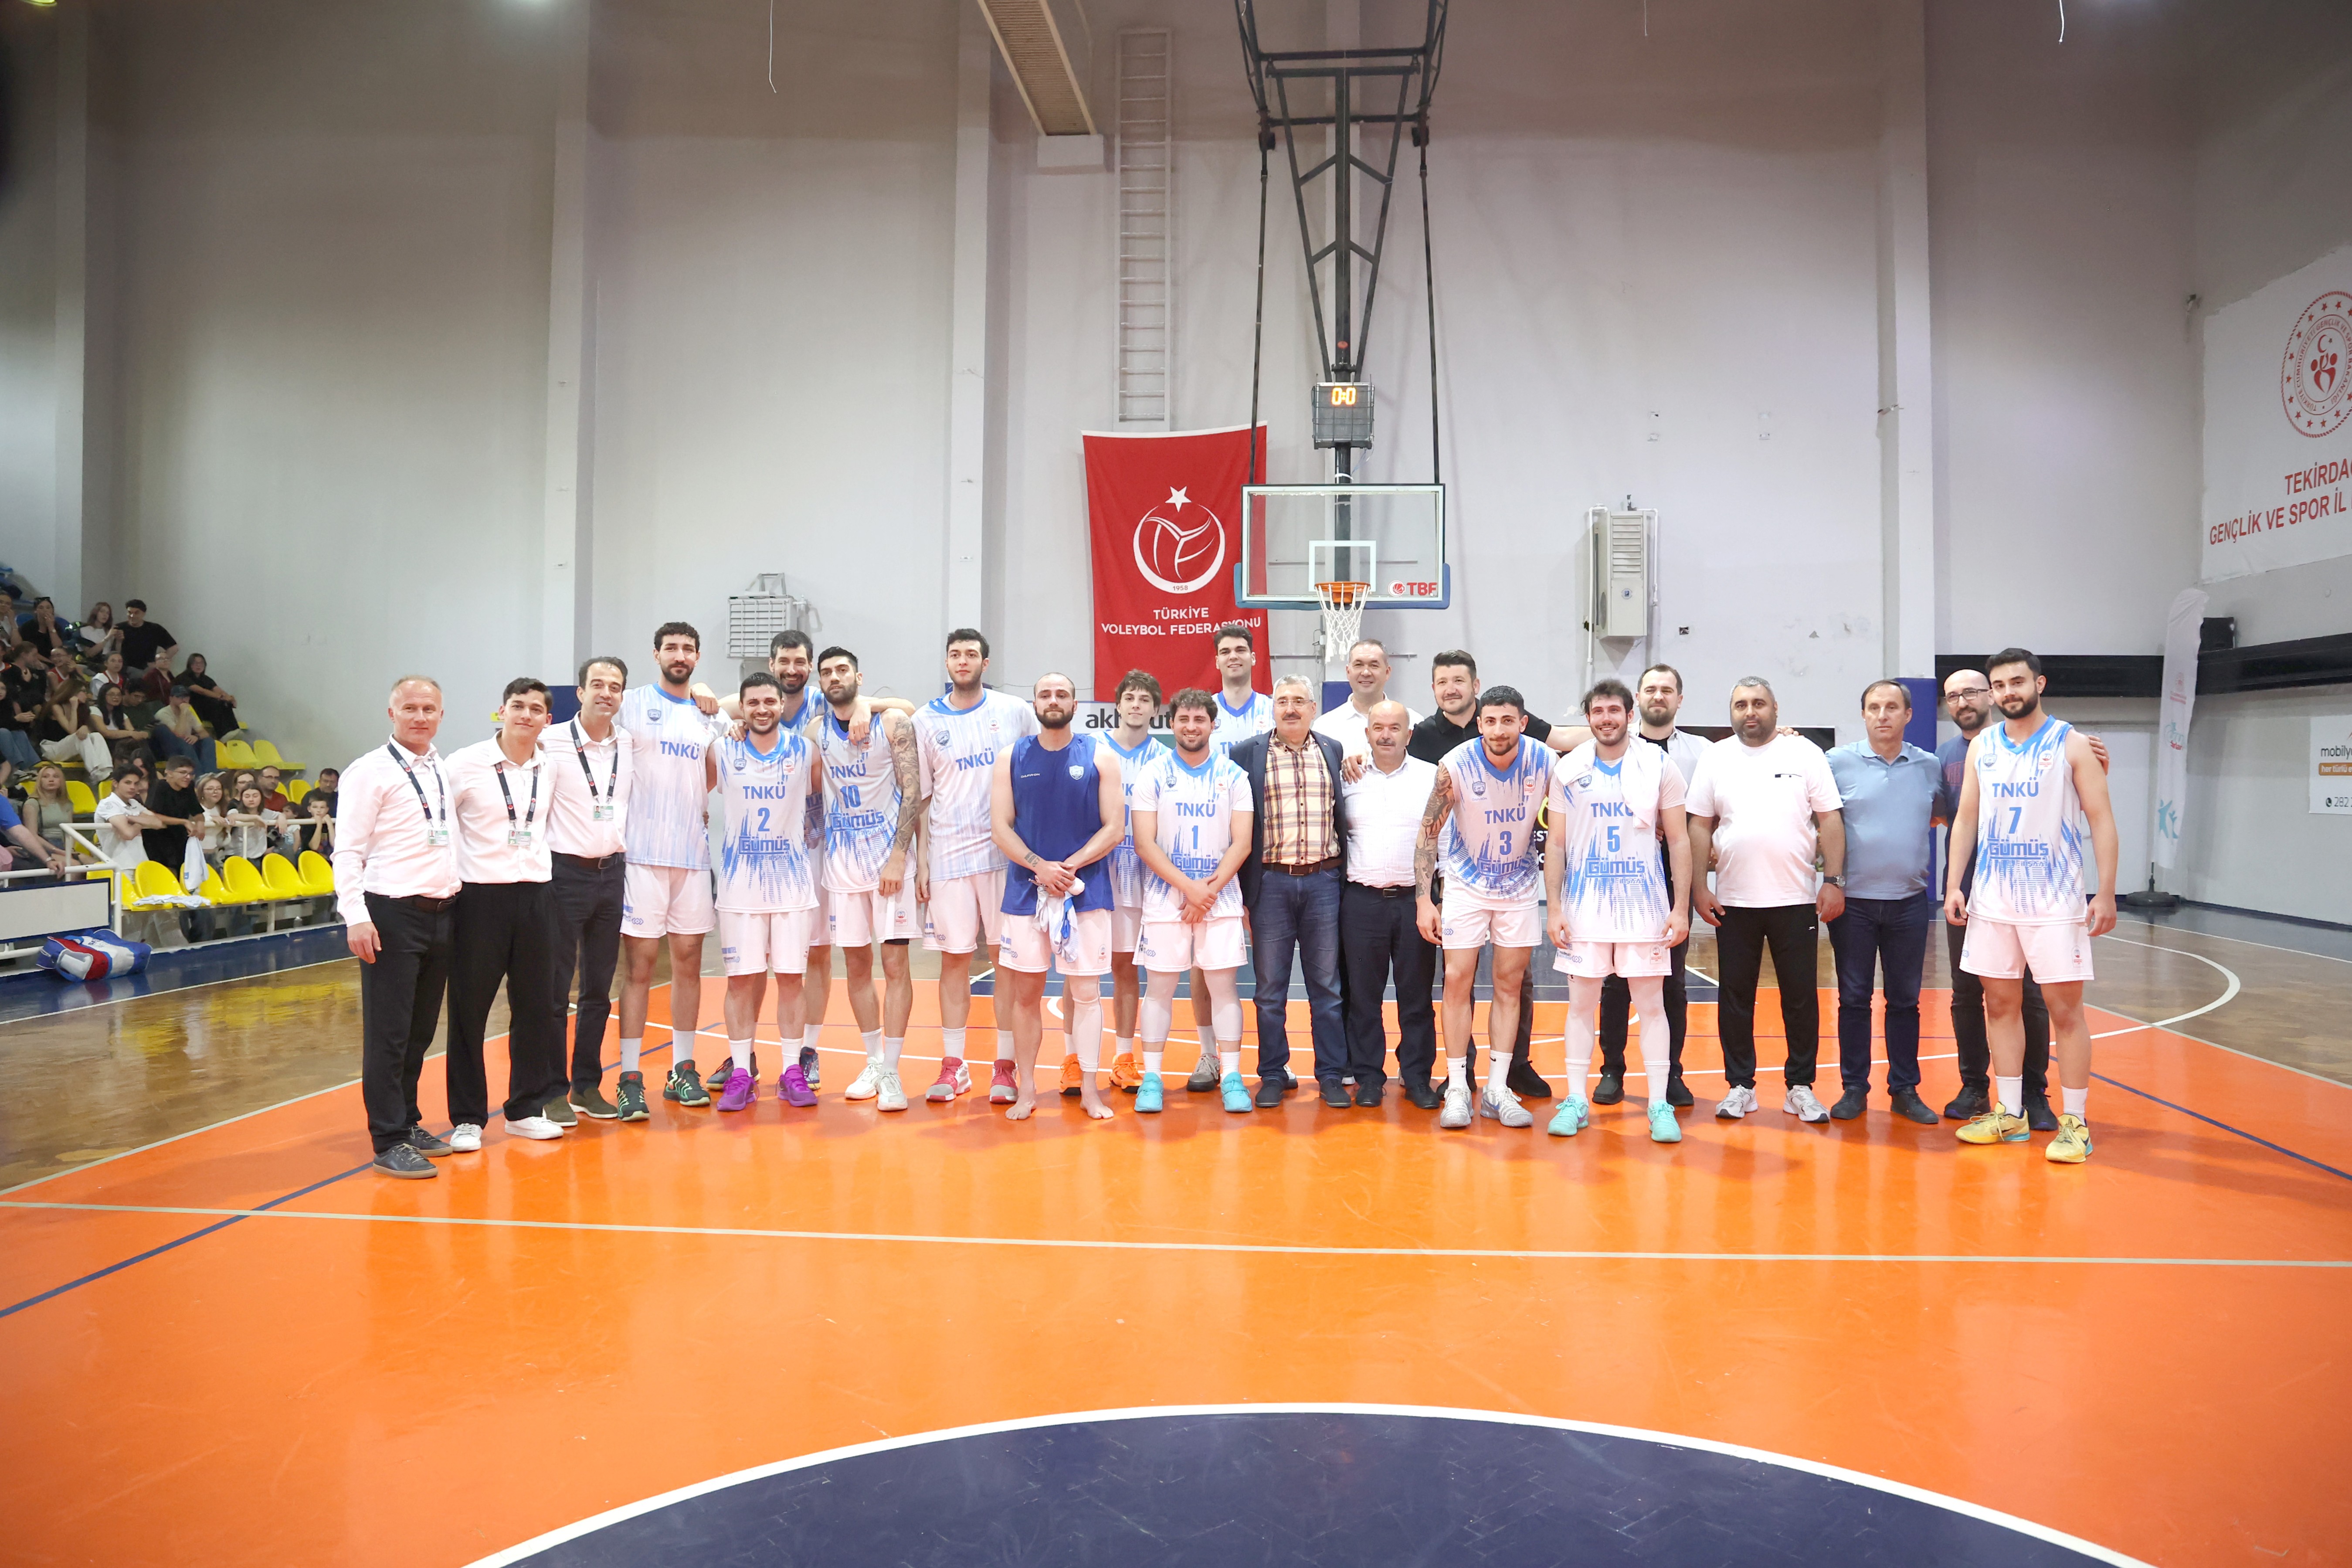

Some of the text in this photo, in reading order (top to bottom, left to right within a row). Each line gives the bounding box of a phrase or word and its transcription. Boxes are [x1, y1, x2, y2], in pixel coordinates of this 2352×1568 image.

[2284, 458, 2352, 495] TEKİRDA
[2210, 486, 2346, 545] GENÇLİK VE SPOR İL
[1406, 582, 1437, 596] TBF
[1153, 606, 1209, 620] TÜRKİYE
[1101, 623, 1166, 635] VOLEYBOL
[660, 741, 700, 760] TNKÜ
[956, 747, 994, 771] TNKÜ
[830, 759, 866, 779] TNKÜ
[743, 781, 786, 799] TNKÜ
[840, 785, 862, 808] 10
[1992, 777, 2039, 798] TNKÜ
[1175, 799, 1216, 817] TNKÜ
[1484, 802, 1526, 824] TNKÜ
[757, 808, 770, 832] 2
[2008, 807, 2022, 834] 7
[1191, 825, 1199, 849] 1
[1499, 831, 1512, 855] 3
[1607, 826, 1620, 852] 5
